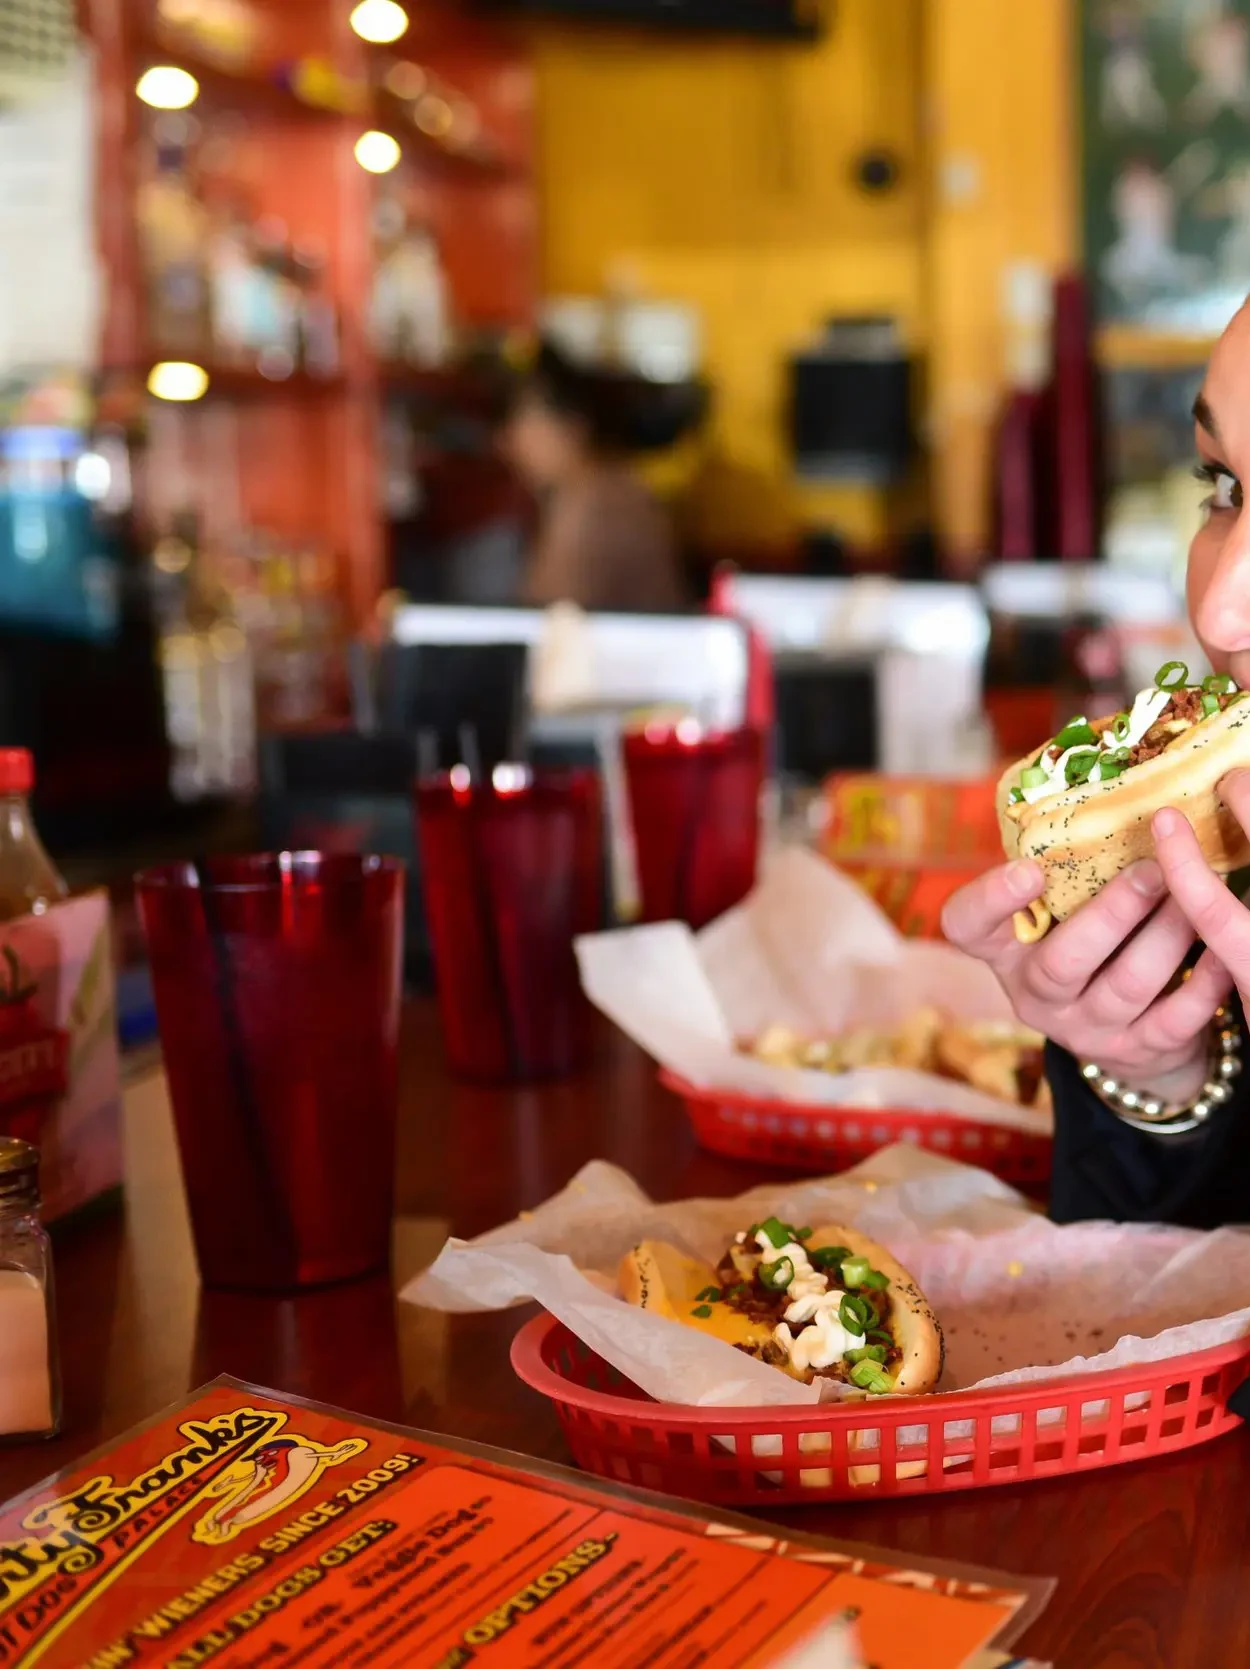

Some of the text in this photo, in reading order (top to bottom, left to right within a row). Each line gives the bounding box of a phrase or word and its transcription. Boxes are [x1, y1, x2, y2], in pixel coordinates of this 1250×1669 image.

[31, 1412, 277, 1534] Frank's
[111, 1476, 203, 1549] PALACE
[133, 1553, 264, 1637] WIENERS
[259, 1499, 344, 1553] SINCE
[336, 1454, 418, 1504] 2009!
[233, 1566, 322, 1628] DOGS
[319, 1520, 394, 1568] GET:
